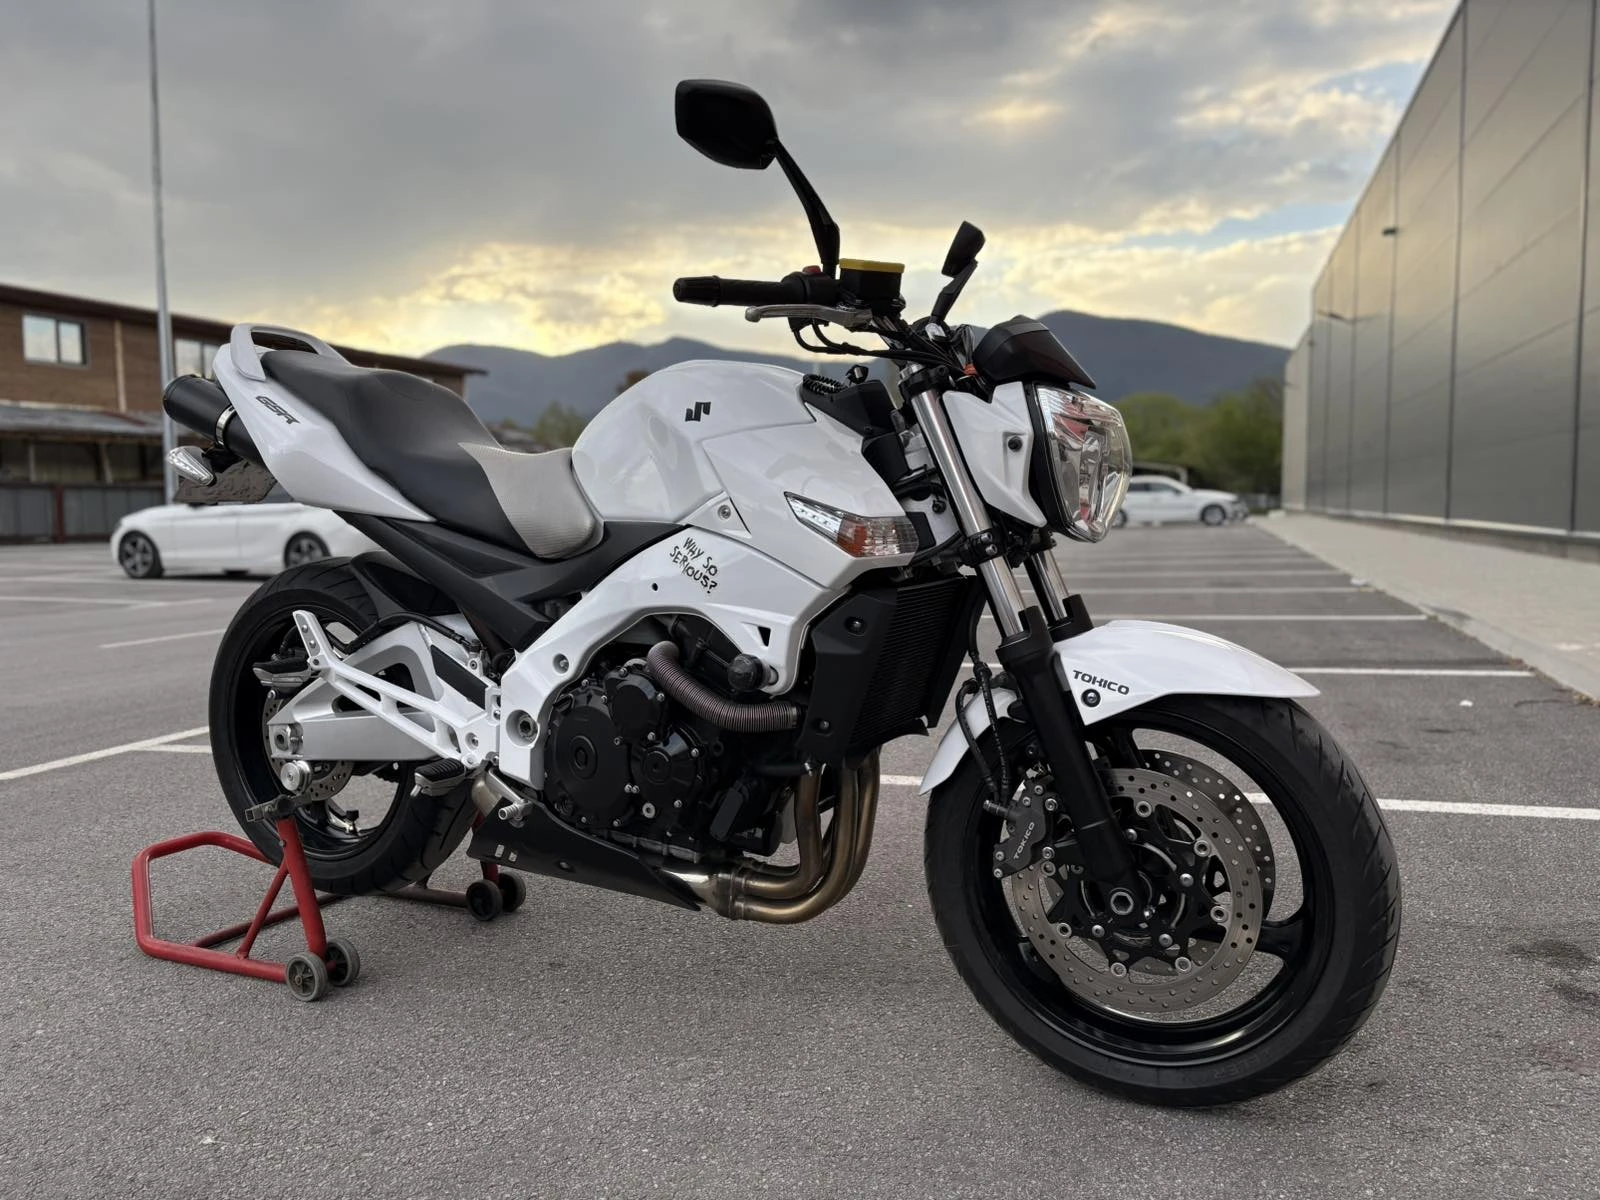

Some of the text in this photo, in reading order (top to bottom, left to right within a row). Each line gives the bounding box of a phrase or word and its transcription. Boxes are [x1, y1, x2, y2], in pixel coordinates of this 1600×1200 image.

[256, 396, 300, 424] GSR
[670, 546, 718, 594] SERIOUS?
[683, 537, 718, 576] WHY SO
[1013, 822, 1035, 859] TOKICO
